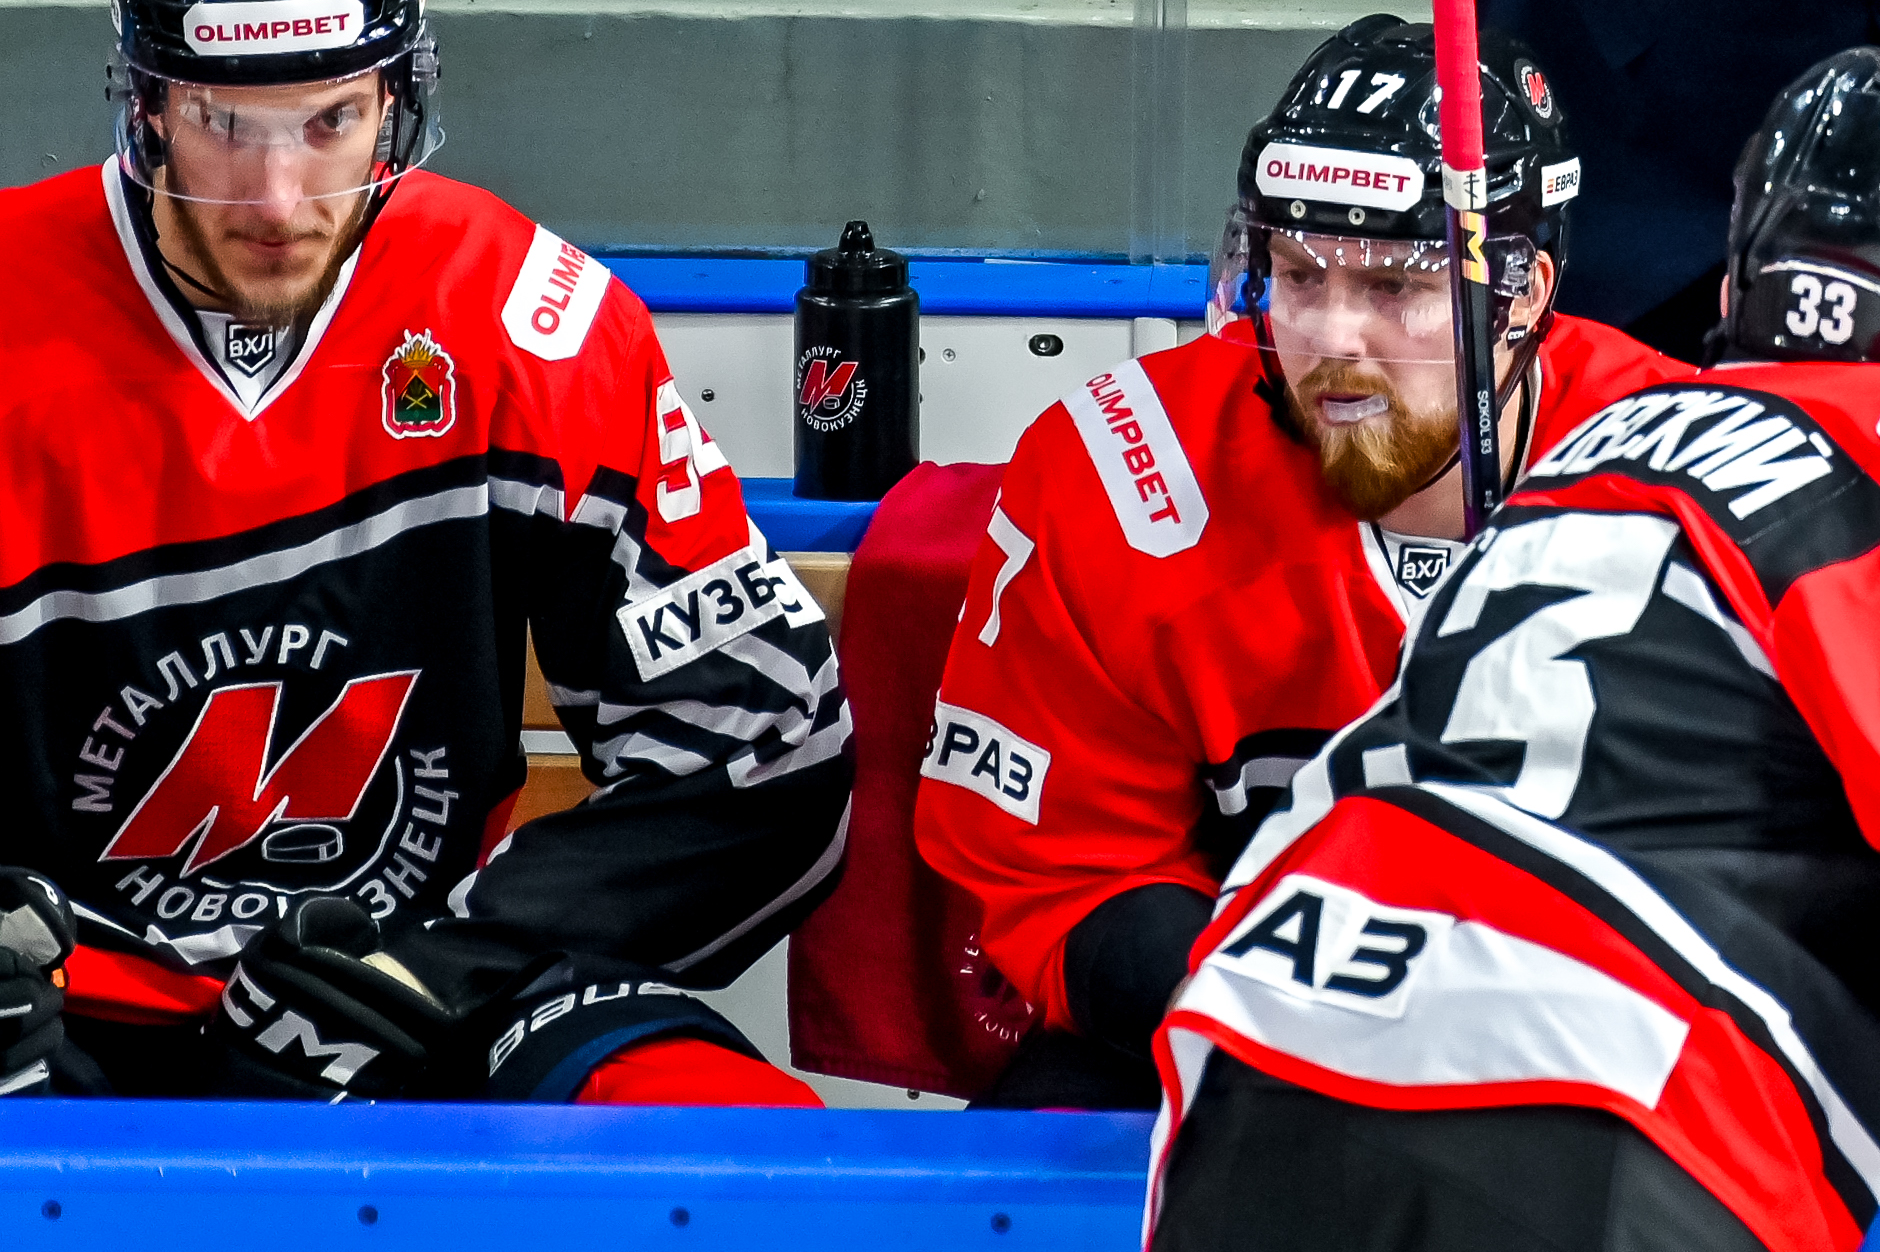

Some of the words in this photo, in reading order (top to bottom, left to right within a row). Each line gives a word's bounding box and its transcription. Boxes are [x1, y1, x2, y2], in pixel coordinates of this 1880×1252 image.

[194, 13, 350, 43] OLIMPBET
[1327, 69, 1405, 114] 17
[1266, 159, 1411, 193] OLIMPBET
[1555, 169, 1578, 192] ЕВРАЗ
[1786, 274, 1857, 345] 33
[229, 333, 273, 358] ВХЛ
[801, 379, 868, 432] НОВОКУЗНЕЦК
[1477, 389, 1491, 437] SOKOL
[1086, 373, 1181, 524] OLIMPBET
[1402, 557, 1447, 581] ВХЛ
[71, 624, 348, 812] МЕТАЛЛУРГ
[115, 746, 460, 920] НОВОЗНЕЦК
